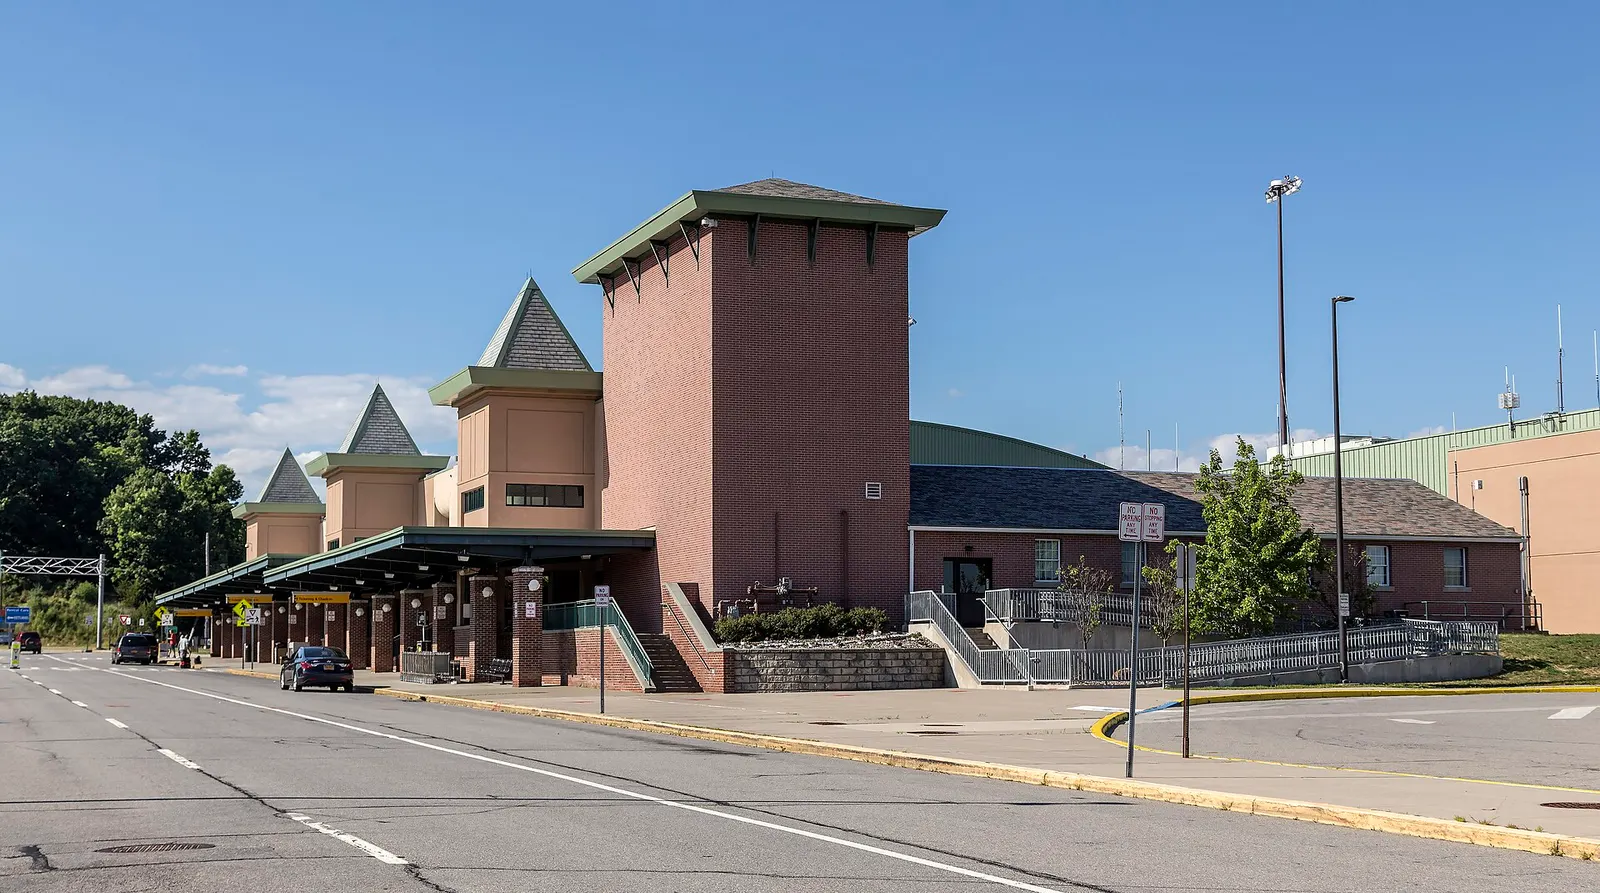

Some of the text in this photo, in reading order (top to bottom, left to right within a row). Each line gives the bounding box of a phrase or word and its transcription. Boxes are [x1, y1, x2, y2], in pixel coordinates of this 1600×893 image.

[1127, 506, 1136, 514] NO
[1149, 507, 1158, 515] NO
[1122, 514, 1141, 522] PARKING
